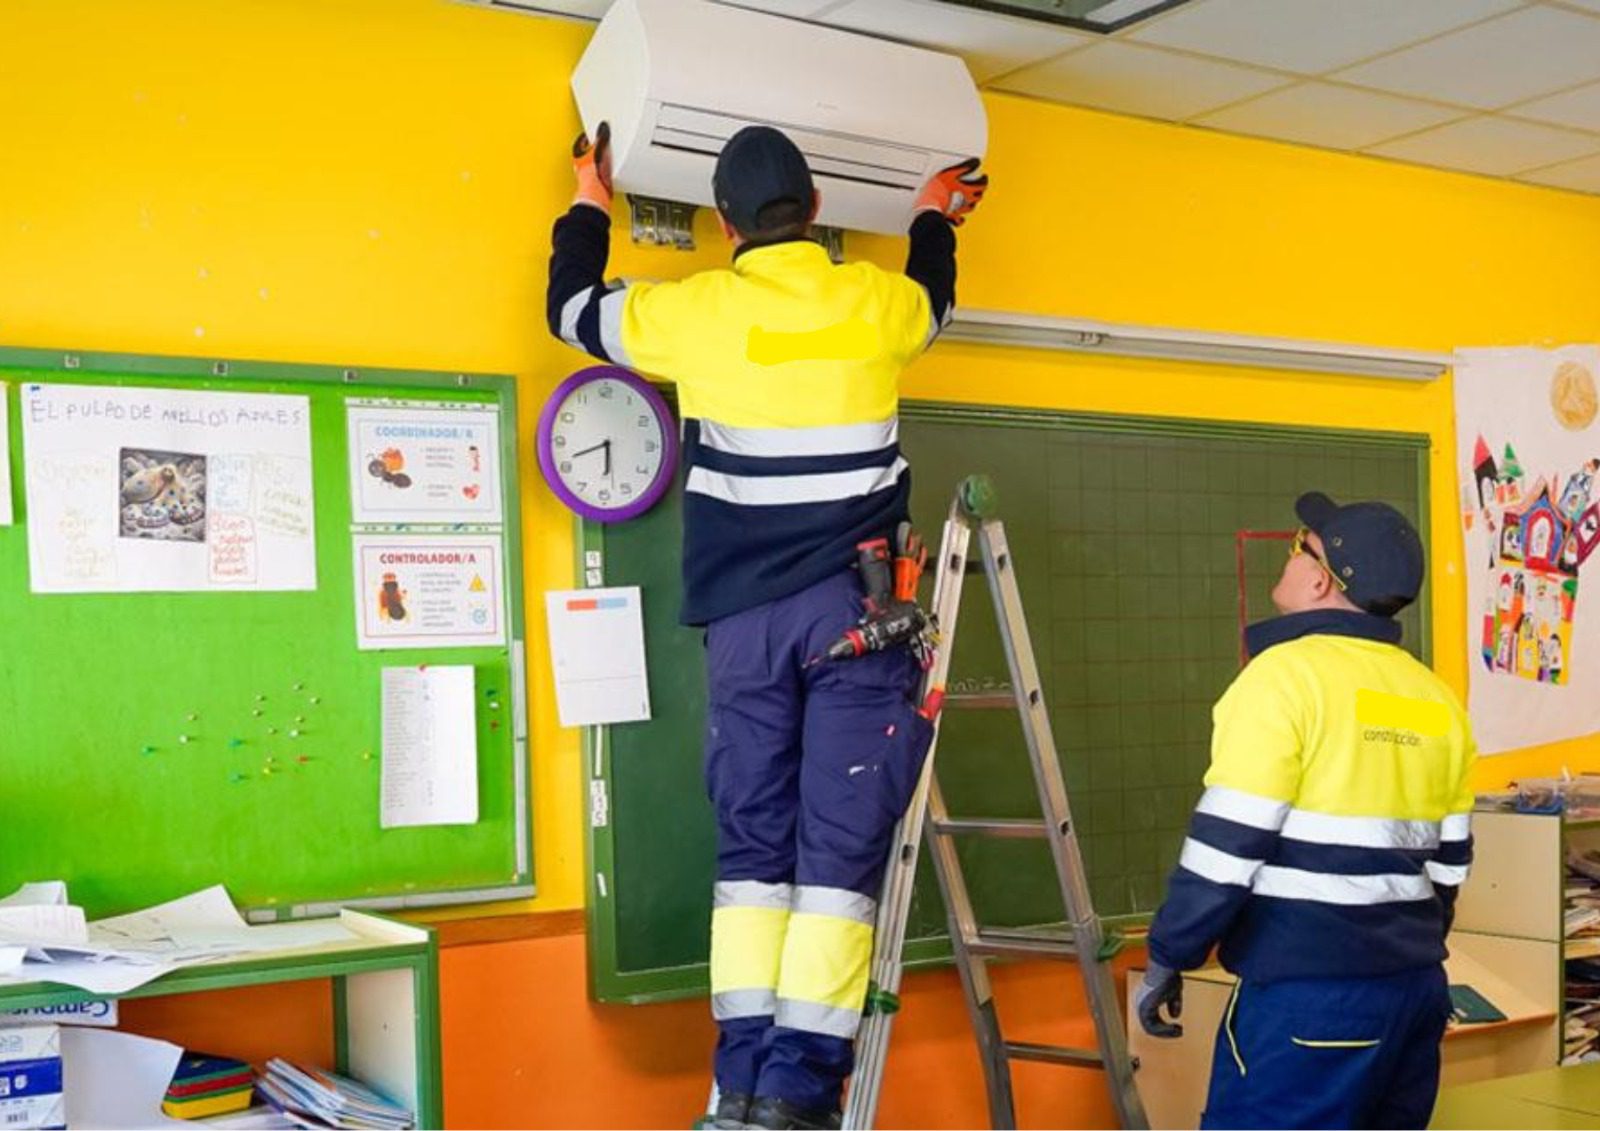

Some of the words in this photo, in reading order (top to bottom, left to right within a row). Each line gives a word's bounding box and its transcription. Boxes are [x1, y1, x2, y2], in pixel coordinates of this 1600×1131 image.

[31, 399, 60, 423] EL
[66, 400, 126, 420] PULPO
[130, 403, 153, 421] DE
[379, 553, 477, 565] CONTROLADOR/A
